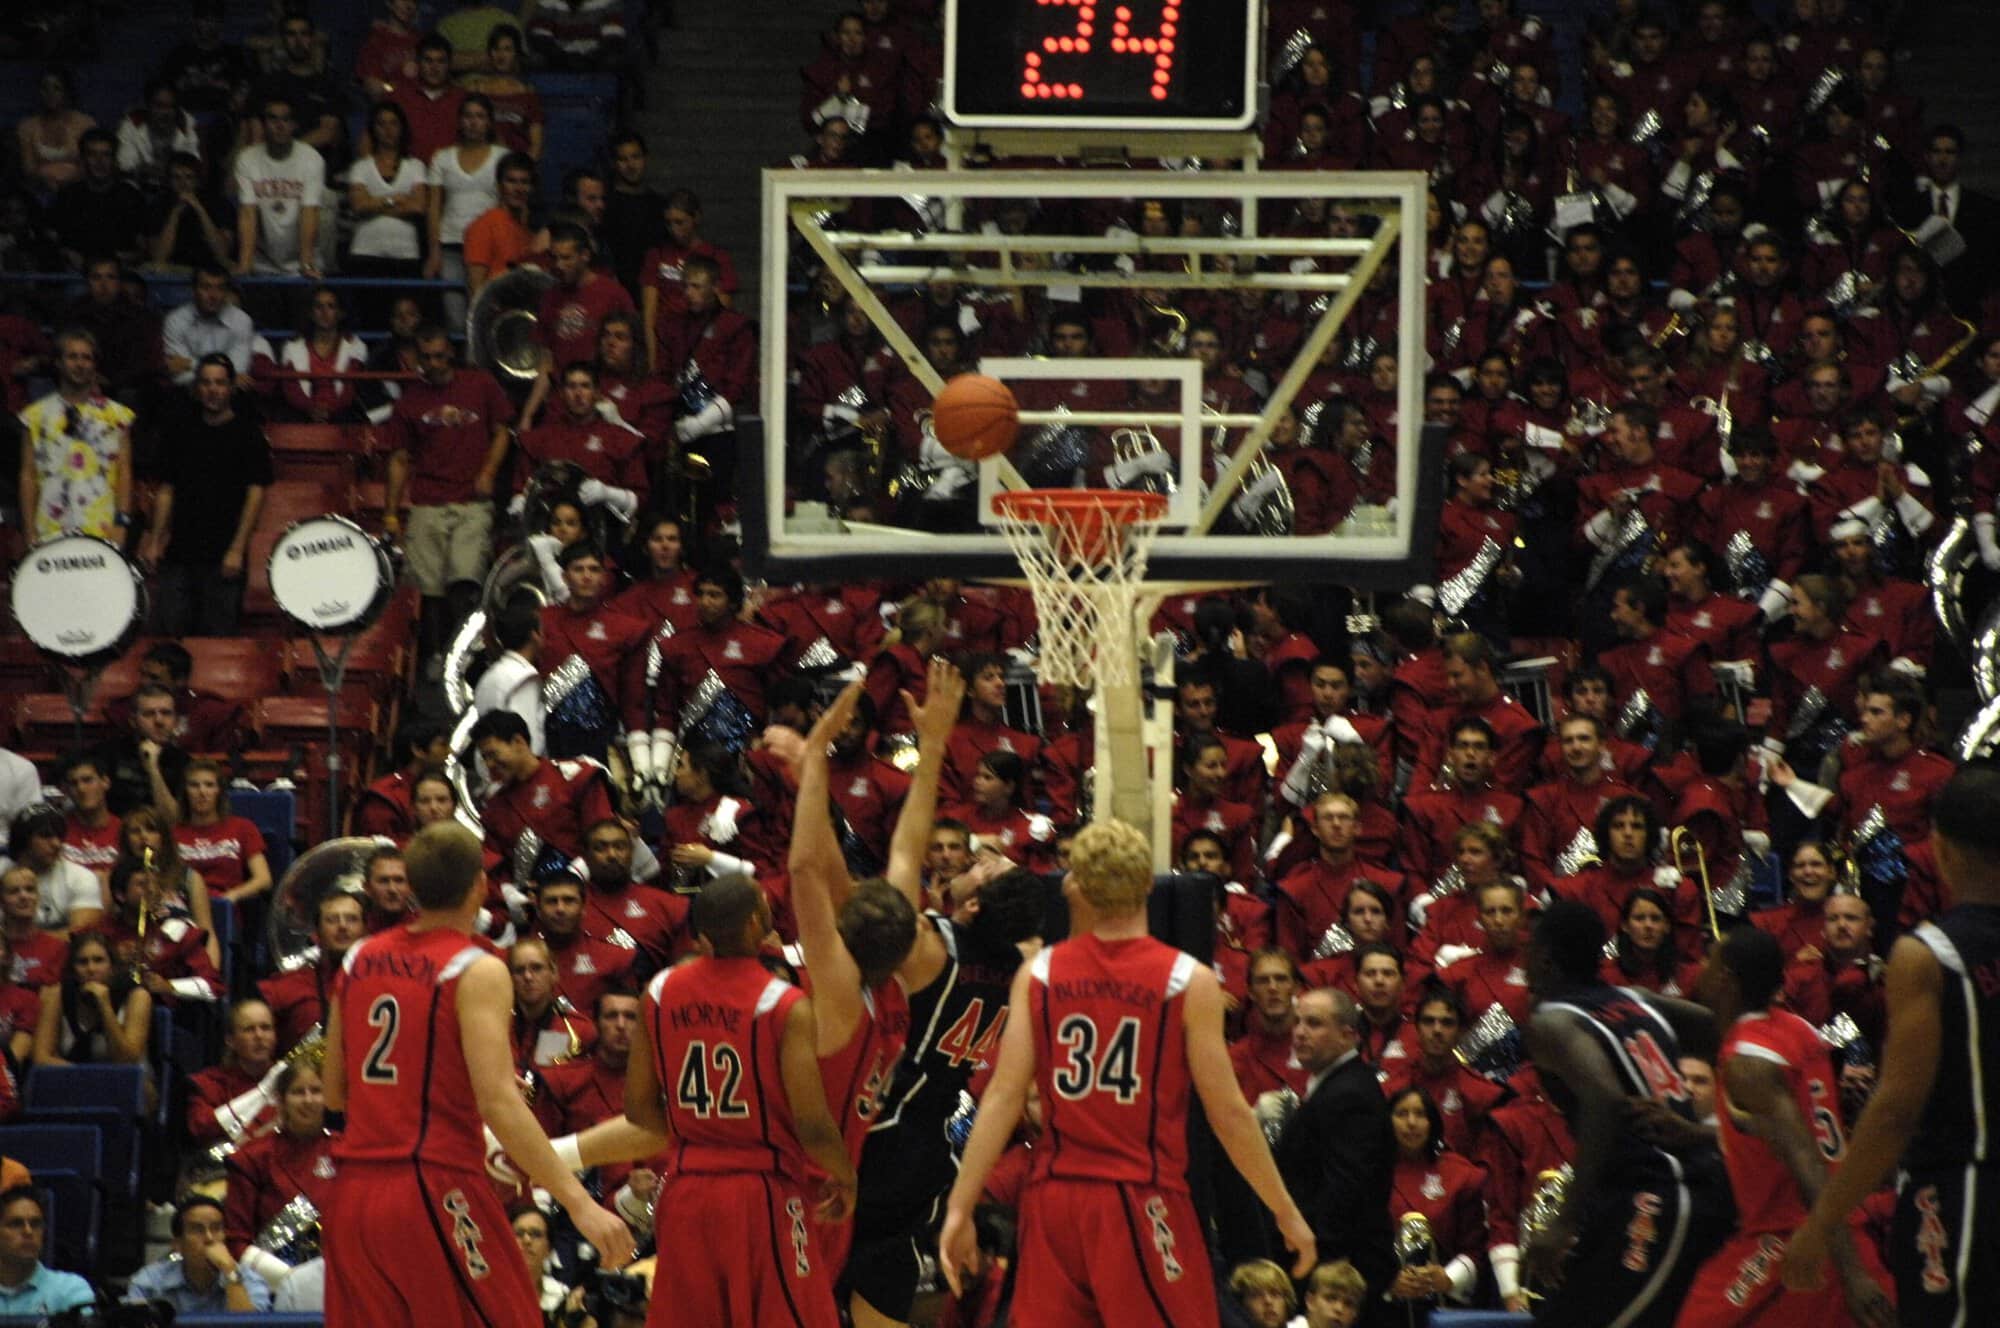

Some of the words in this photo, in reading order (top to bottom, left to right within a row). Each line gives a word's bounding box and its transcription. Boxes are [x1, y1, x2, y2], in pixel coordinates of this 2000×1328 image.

[1020, 0, 1182, 100] 24
[52, 554, 107, 572] YAMAHA
[302, 535, 355, 558] YAMAHA
[361, 993, 401, 1086] 2
[670, 1000, 743, 1034] HORNE
[677, 1040, 751, 1120] 42
[1053, 1012, 1142, 1105] 34
